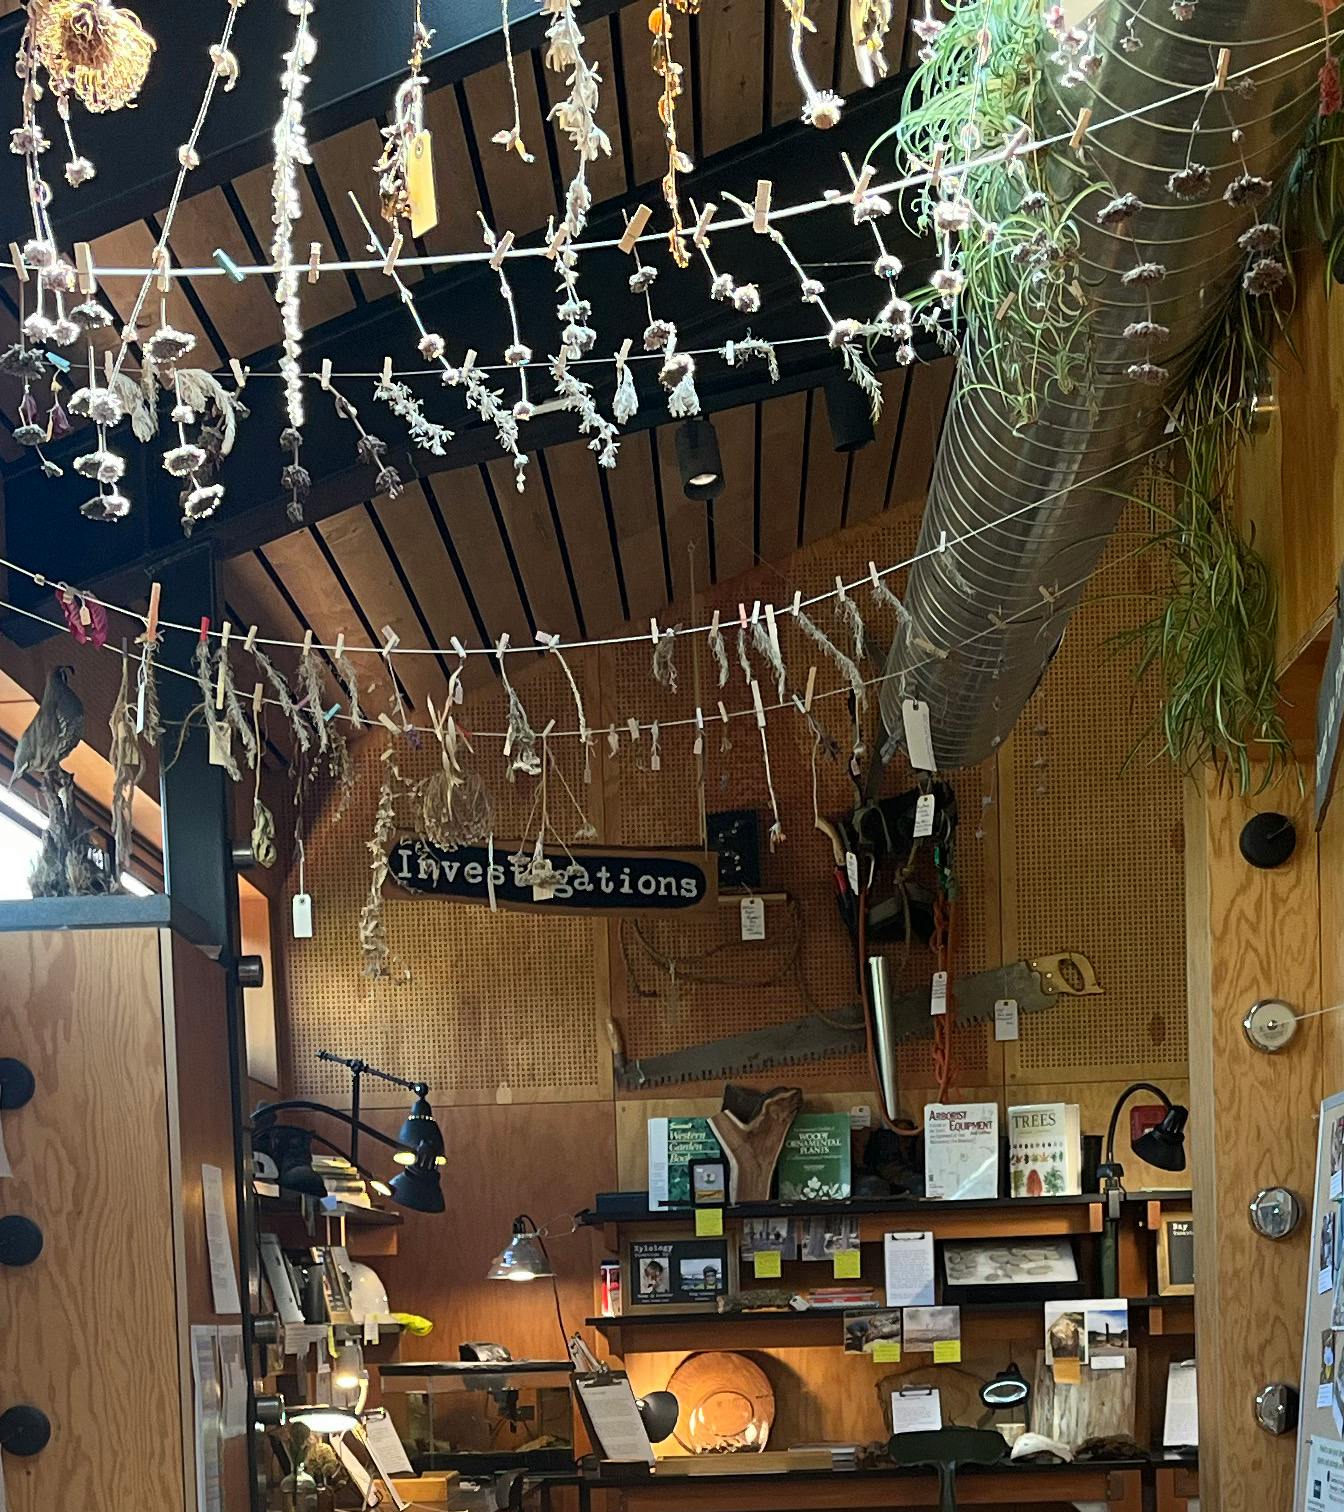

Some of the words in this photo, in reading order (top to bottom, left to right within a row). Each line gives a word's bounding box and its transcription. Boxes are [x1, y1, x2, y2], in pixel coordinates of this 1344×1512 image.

[397, 849, 698, 898] Investgations
[949, 1120, 993, 1132] EQUIPMENT
[1012, 1114, 1057, 1129] TREES
[669, 1131, 706, 1141] Western
[668, 1142, 703, 1152] Garden
[786, 1139, 842, 1147] ORNAMENTAL
[799, 1146, 830, 1155] PLANTS
